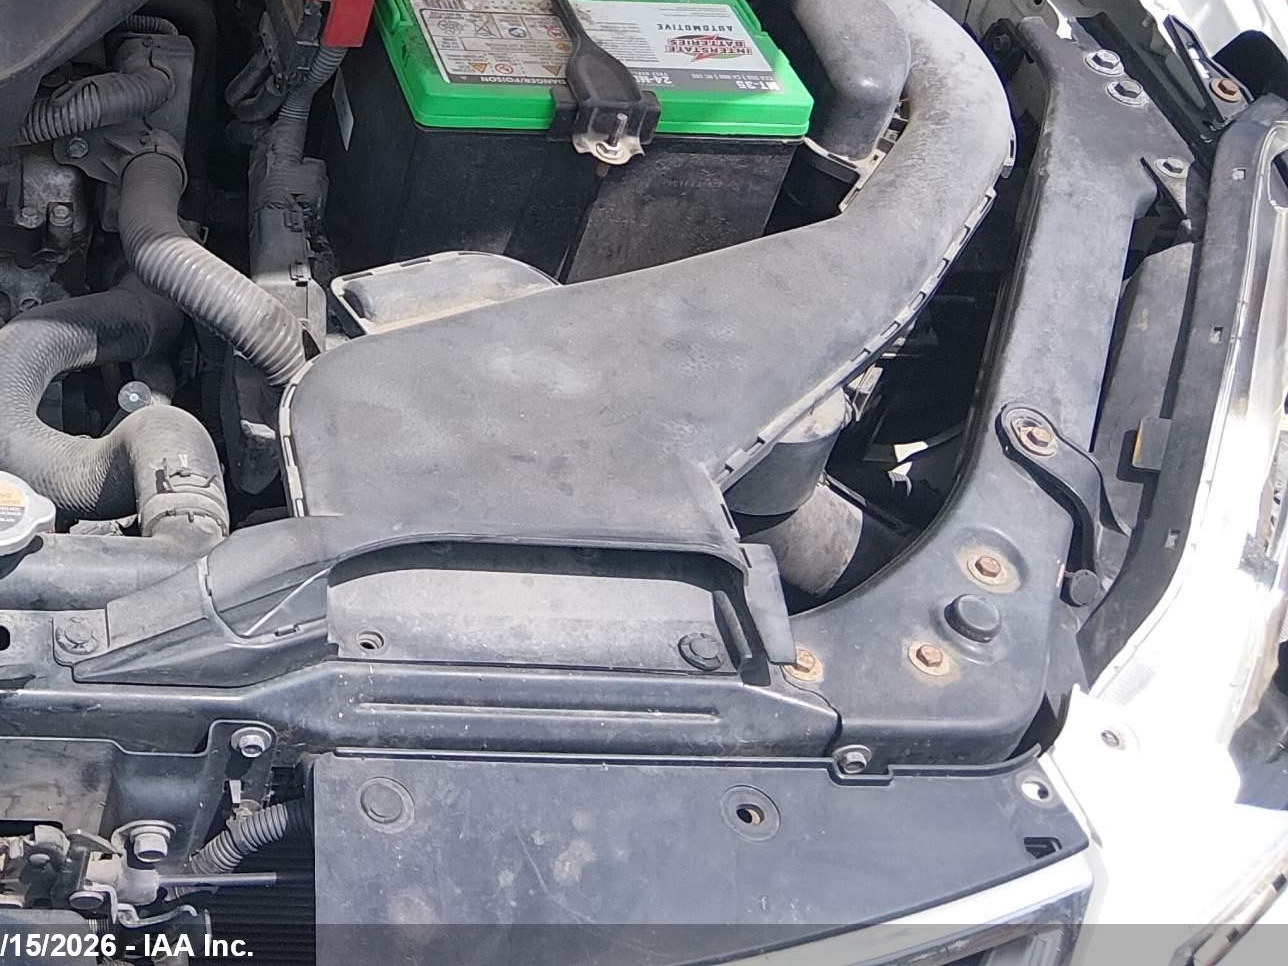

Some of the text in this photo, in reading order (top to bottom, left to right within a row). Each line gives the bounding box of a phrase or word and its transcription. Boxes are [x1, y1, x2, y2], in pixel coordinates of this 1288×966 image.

[657, 23, 733, 32] AUTOMOTIVE
[668, 38, 746, 48] BATTERIES
[665, 45, 752, 55] INTERSTATE
[736, 80, 781, 91] MT-35
